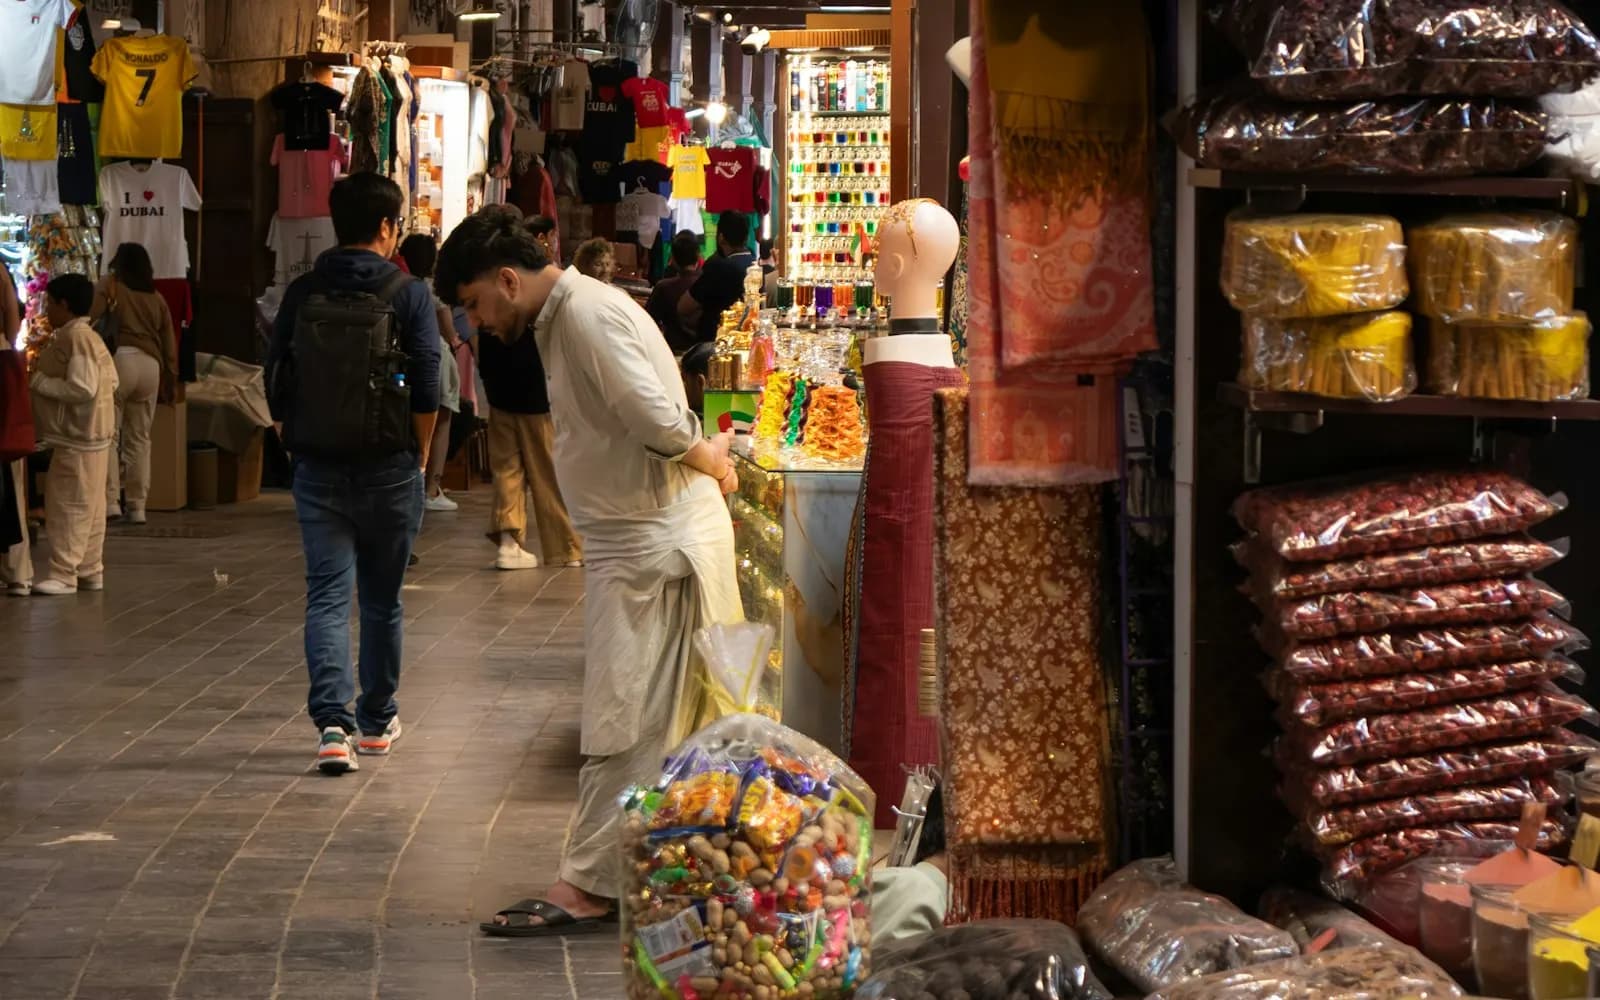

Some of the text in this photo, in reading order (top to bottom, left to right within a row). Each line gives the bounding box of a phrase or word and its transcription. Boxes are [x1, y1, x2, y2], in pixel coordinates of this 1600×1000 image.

[136, 69, 156, 107] 7
[124, 192, 130, 204] I
[120, 206, 165, 217] DUBAI
